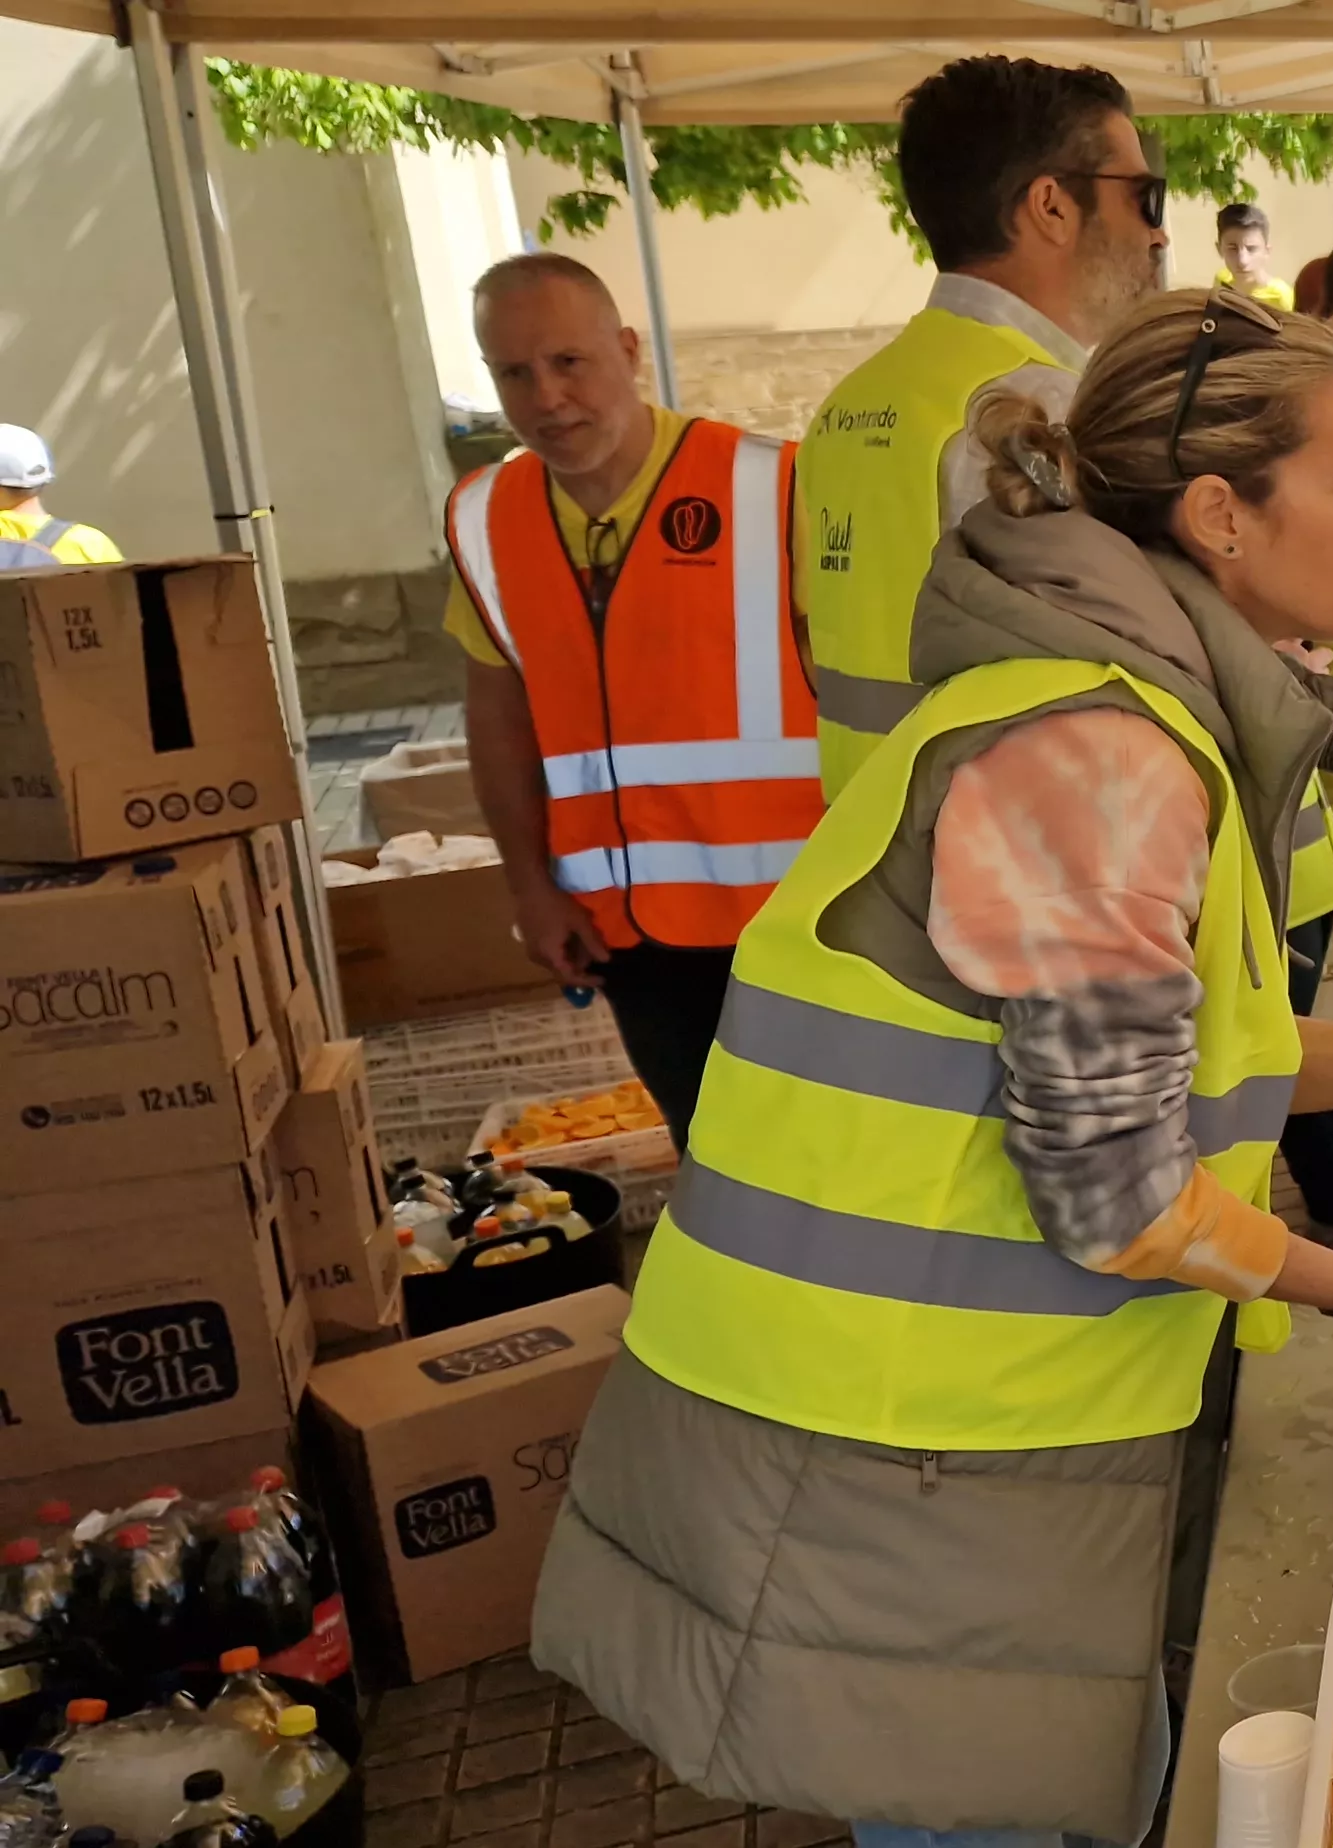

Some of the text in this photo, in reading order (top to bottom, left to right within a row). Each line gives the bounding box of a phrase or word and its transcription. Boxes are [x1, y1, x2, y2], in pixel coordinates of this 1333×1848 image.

[74, 1316, 214, 1370] Font
[79, 1356, 225, 1411] Vella
[406, 1486, 481, 1526] Font
[410, 1512, 487, 1548] Vella
